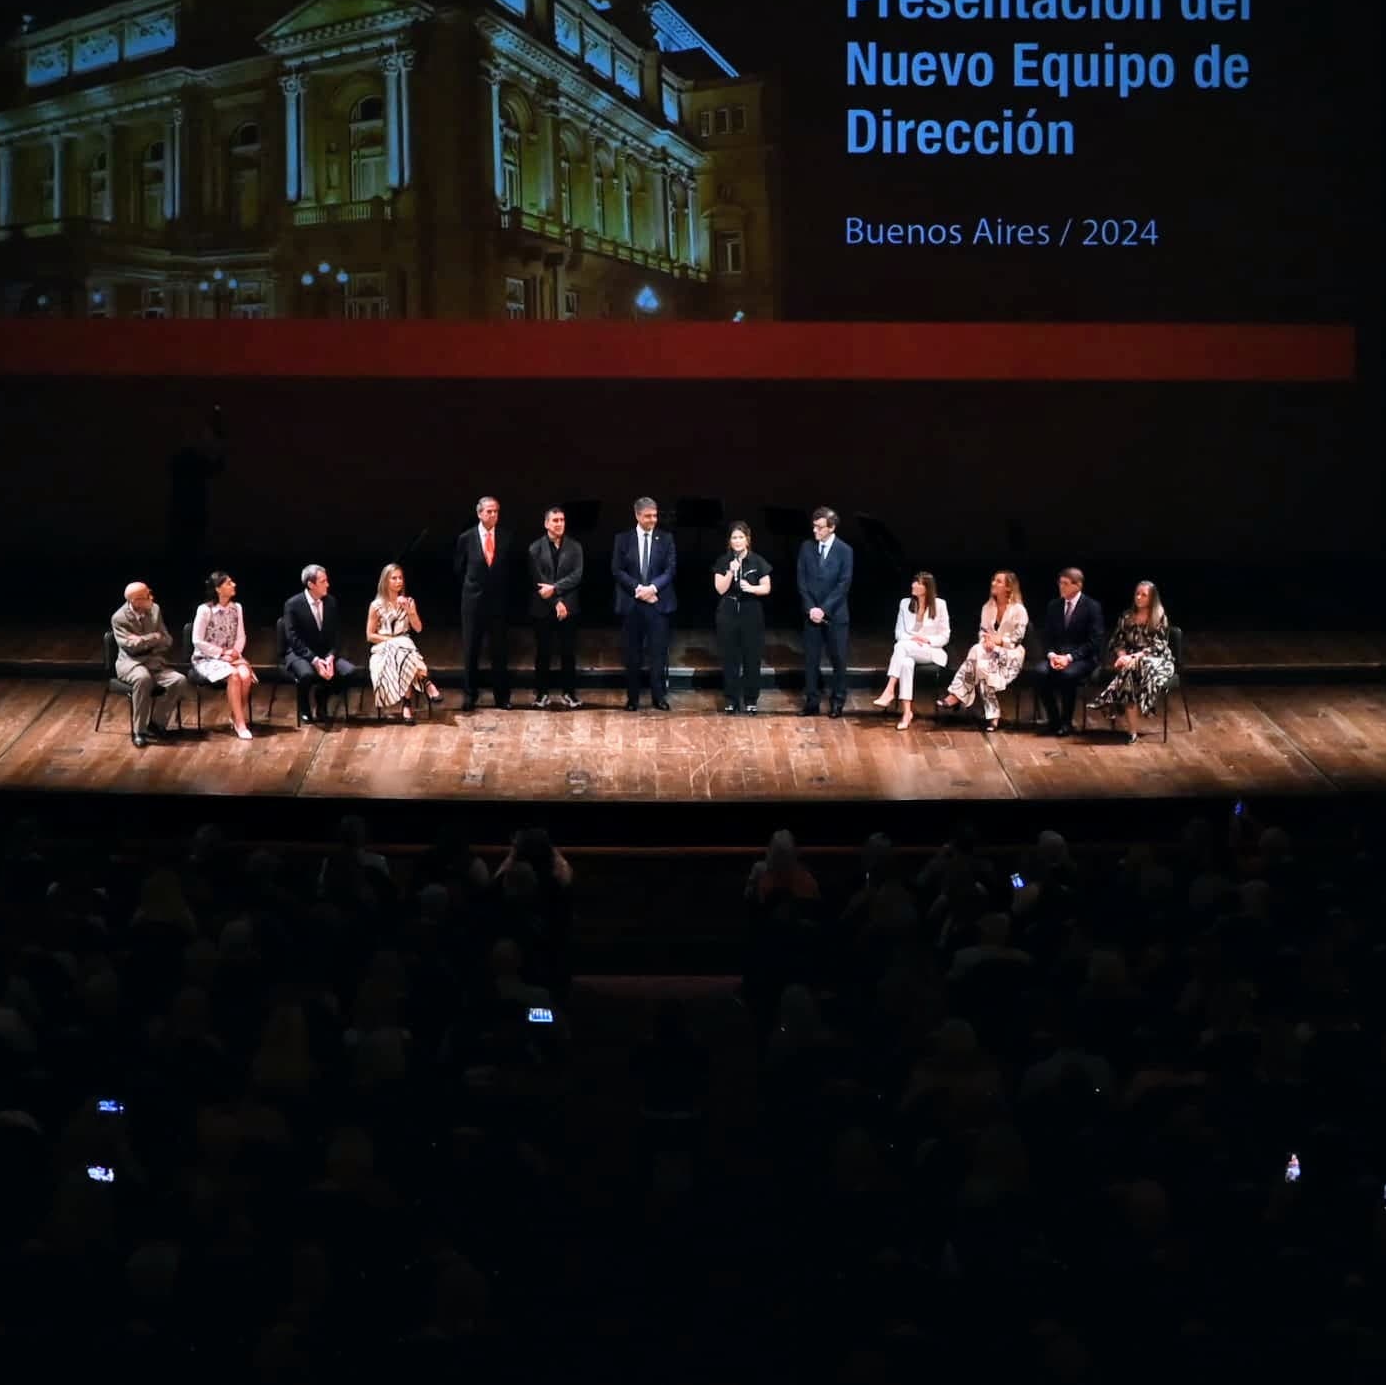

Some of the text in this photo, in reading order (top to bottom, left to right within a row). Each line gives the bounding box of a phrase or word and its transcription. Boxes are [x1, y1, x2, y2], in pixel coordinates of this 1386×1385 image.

[846, 41, 1250, 98] Nuevo Equipo de
[846, 108, 1075, 155] Dirección
[845, 217, 1159, 247] Buenos Aires / 2024
